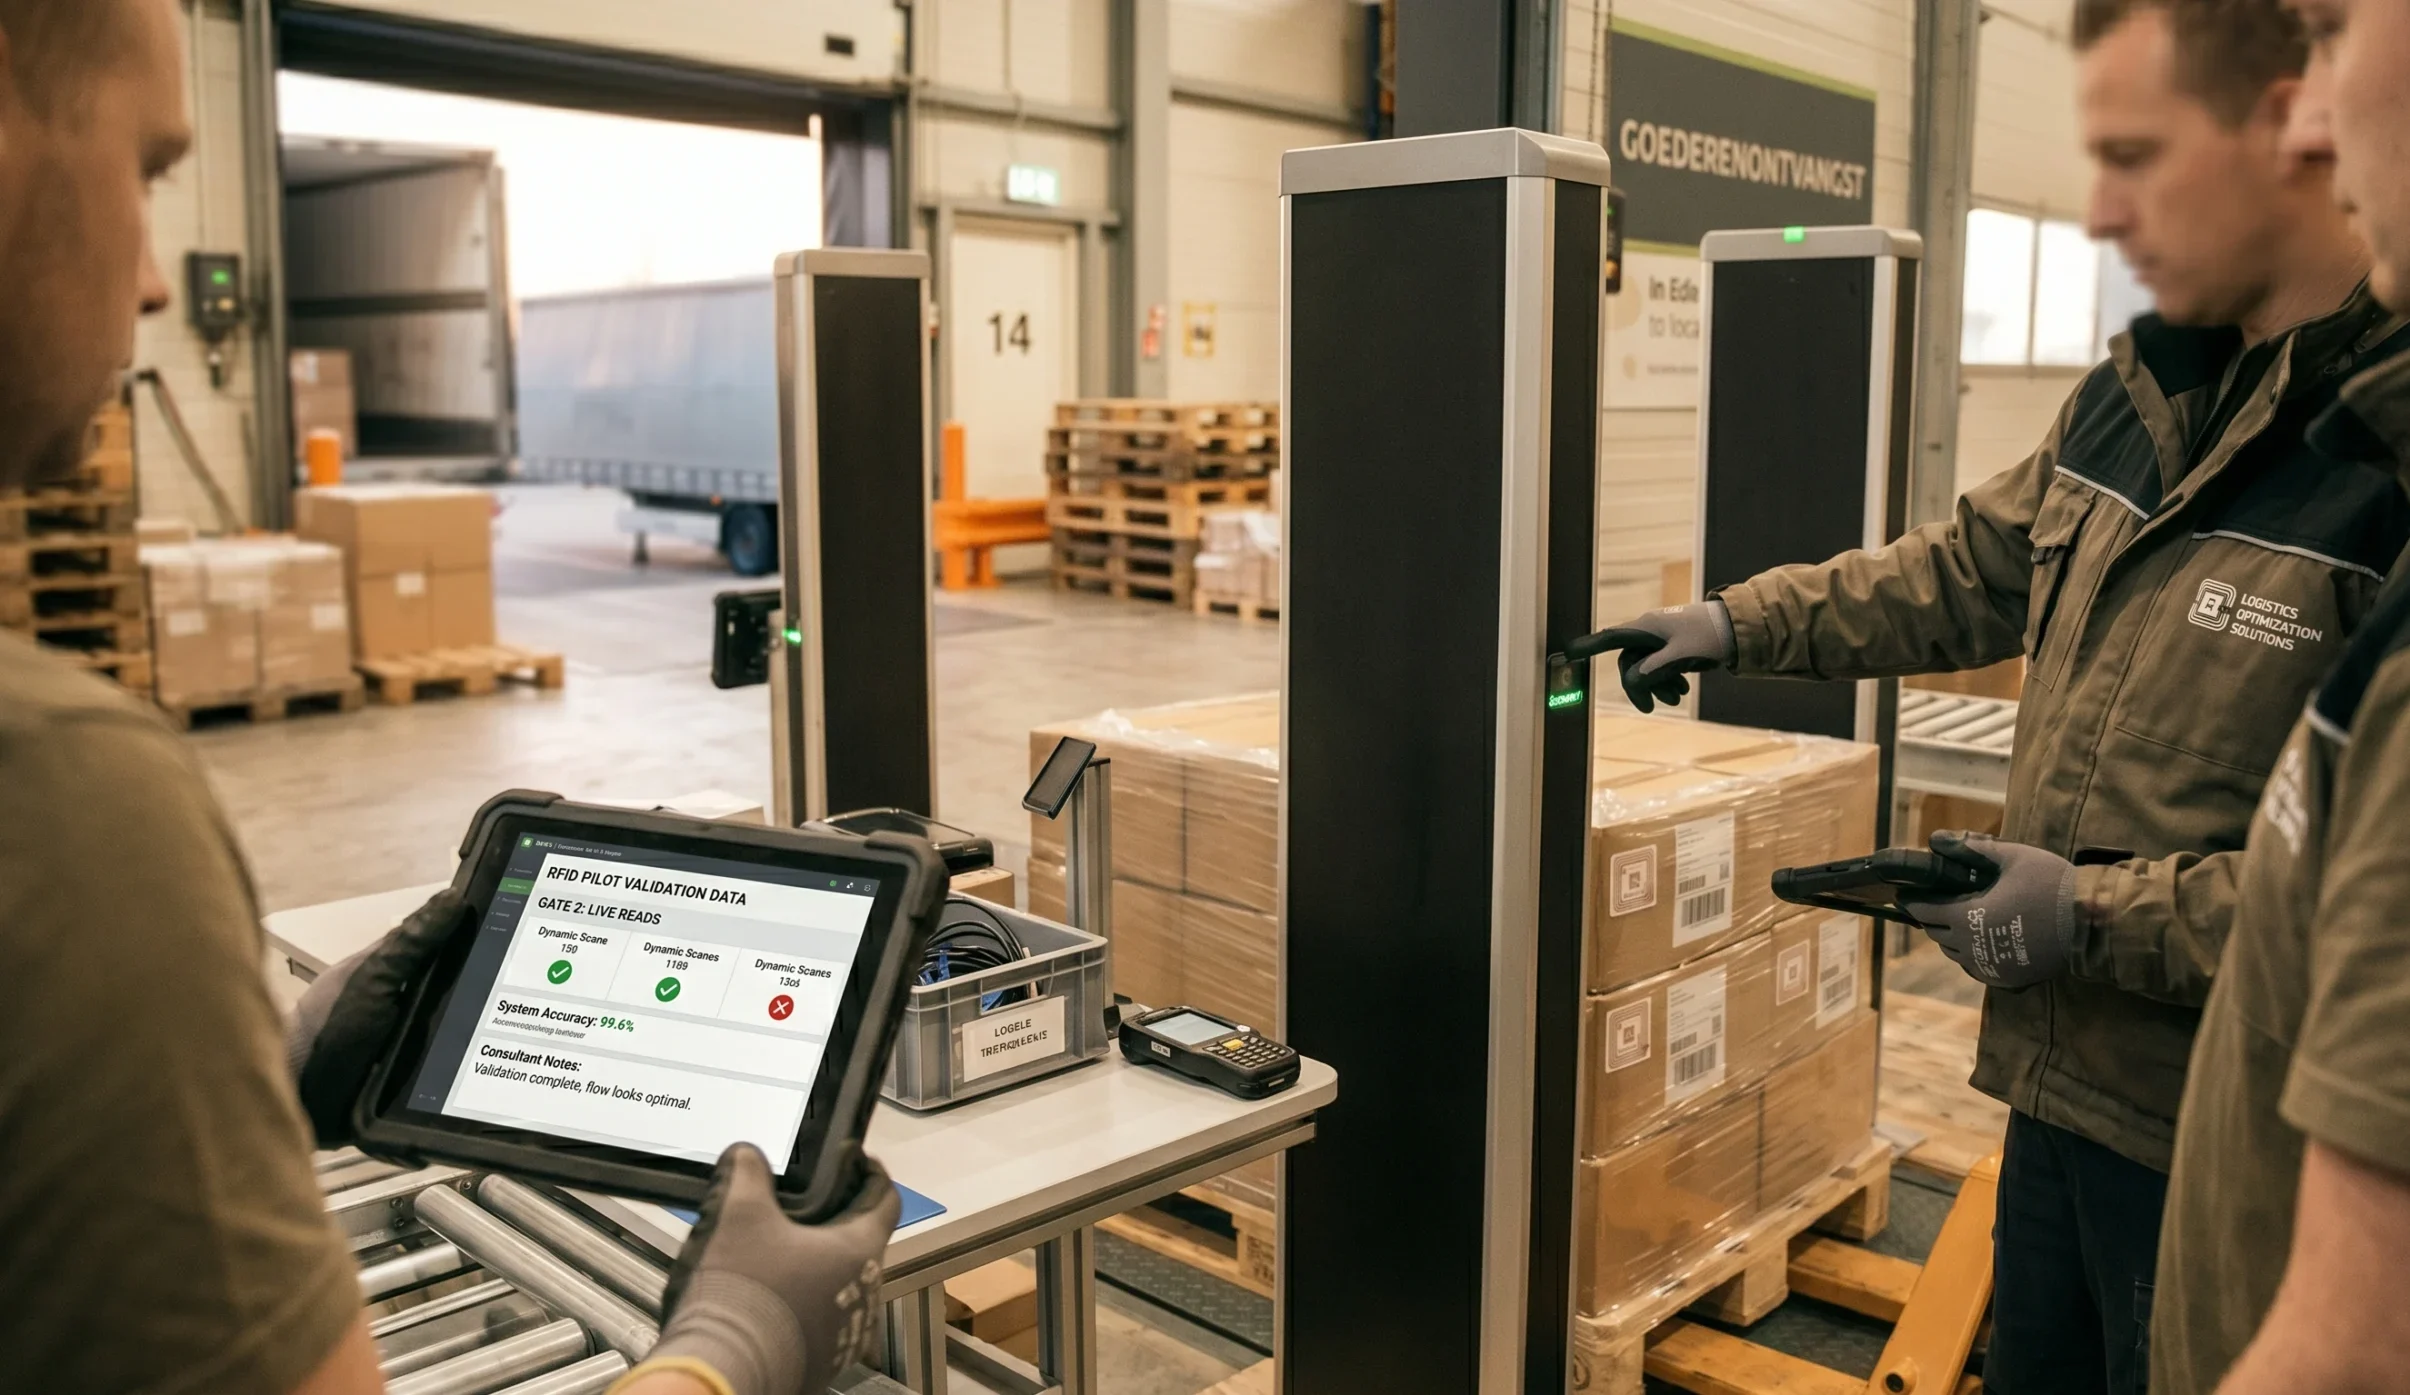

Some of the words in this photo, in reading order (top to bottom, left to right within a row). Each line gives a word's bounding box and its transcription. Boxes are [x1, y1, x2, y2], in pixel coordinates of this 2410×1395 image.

[1619, 117, 1867, 201] GOEDERENONTVANGST
[985, 313, 1033, 357] 14
[1648, 313, 1666, 338] to
[2240, 593, 2299, 620] LOGISTICS
[2230, 622, 2295, 651] SOLUTIONS
[2235, 608, 2323, 642] OPTIMIZATION
[546, 866, 579, 882] RFID
[581, 871, 622, 888] PILOT
[625, 876, 708, 900] VALIDATION
[709, 888, 747, 906] DATA
[538, 896, 573, 912] GATE
[573, 902, 586, 914] 2:
[587, 904, 618, 919] LIVE
[617, 908, 662, 925] READS
[537, 926, 579, 943] Dynamic
[579, 931, 609, 946] Scane
[560, 943, 579, 955] 150
[643, 941, 685, 957] Dynamic
[685, 948, 720, 962] Scanes
[665, 959, 689, 971] 1189
[754, 958, 796, 975] Dynamic
[797, 965, 832, 979] Scanes
[497, 1000, 540, 1018] System
[541, 1006, 598, 1028] Accuracy:
[600, 1016, 635, 1033] 99.6%
[994, 1018, 1032, 1038] LOGELE
[480, 1044, 543, 1066] Consultant
[543, 1055, 582, 1072] Notes:
[474, 1062, 527, 1083] Validation
[529, 1072, 582, 1093] complete,
[585, 1080, 611, 1096] flow
[612, 1085, 644, 1102] looks
[645, 1094, 692, 1111] optimal.
